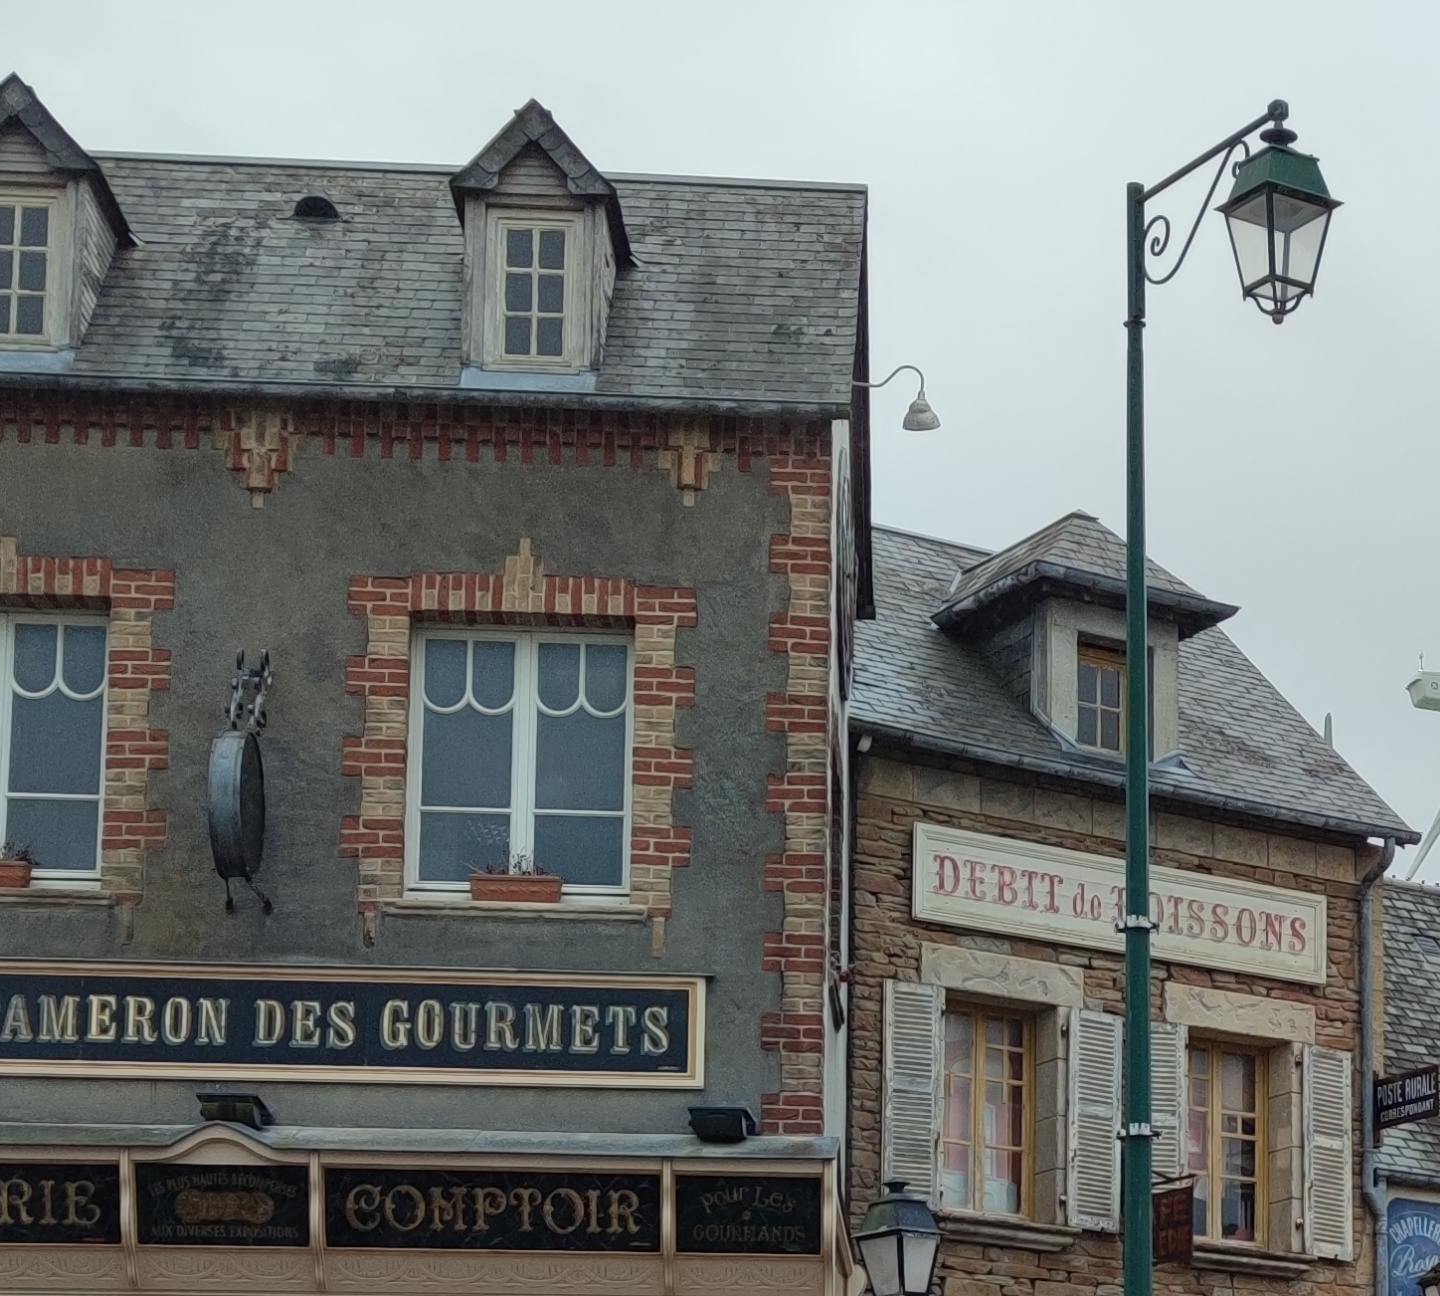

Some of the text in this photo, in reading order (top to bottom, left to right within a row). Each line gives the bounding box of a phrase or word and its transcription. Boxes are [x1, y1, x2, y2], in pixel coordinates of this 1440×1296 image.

[933, 854, 1063, 914] DEBIT
[1072, 883, 1102, 920] de
[253, 999, 356, 1049] DES
[379, 1000, 670, 1056] GOURMETS
[1377, 1072, 1437, 1107] POSTE RURALE
[1380, 1098, 1434, 1123] CORRESPONDANT
[167, 1176, 191, 1190] PLUS
[345, 1184, 641, 1234] COMPTOIR
[151, 1225, 299, 1238] AUX DIVERSES EXPOSITIONS
[693, 1225, 806, 1243] GOURMANDS
